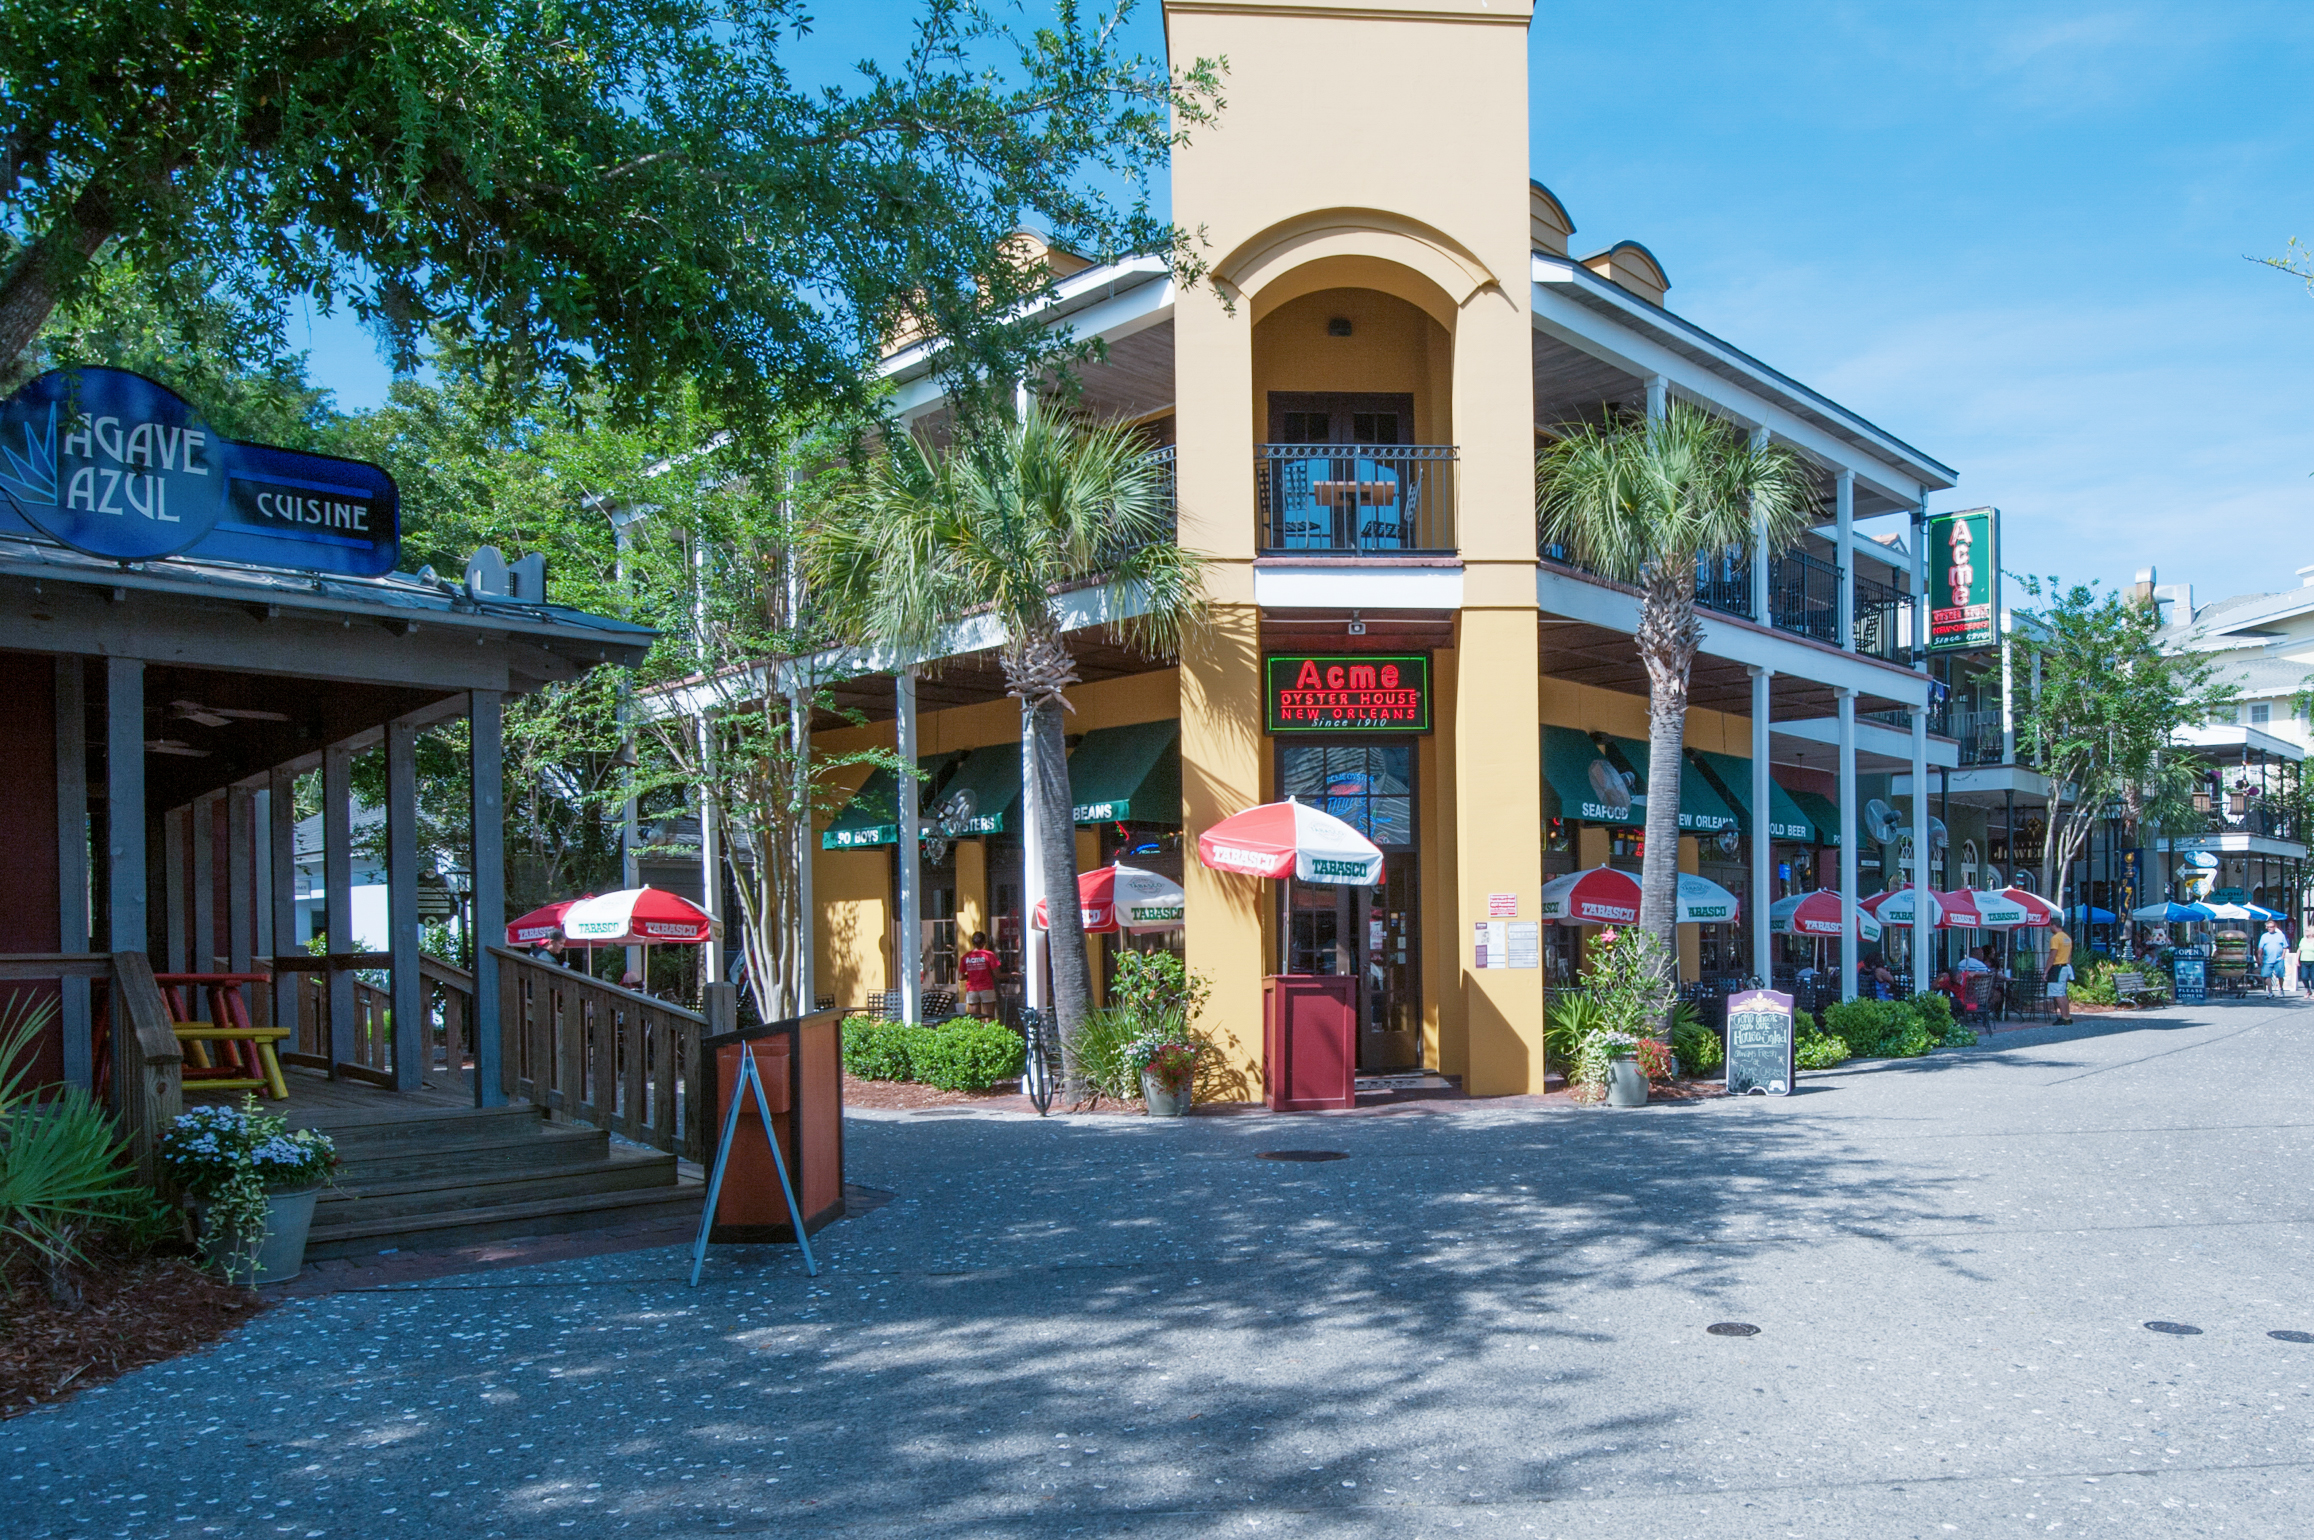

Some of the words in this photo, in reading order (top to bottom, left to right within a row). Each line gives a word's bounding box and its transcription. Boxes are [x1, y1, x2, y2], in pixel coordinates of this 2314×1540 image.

[64, 412, 209, 476] AGAVE
[67, 467, 181, 523] AZUL
[257, 492, 370, 532] CUISINE
[1949, 518, 1974, 607] Acme
[1296, 659, 1399, 690] Acme
[1281, 693, 1349, 705] OYSTER
[1360, 692, 1417, 705] HOUSE
[1281, 708, 1320, 720] NEW
[1333, 708, 1416, 719] ORLEANS
[1311, 717, 1349, 728] Since
[1356, 718, 1388, 727] 1910
[1073, 804, 1112, 822] BEANS
[1582, 802, 1629, 820] SEAFOOD
[948, 817, 995, 834] OYSTERS
[1679, 813, 1692, 826] EW
[838, 832, 852, 845] PO
[854, 829, 879, 844] BOYS
[1769, 823, 1785, 836] OLD
[1788, 825, 1807, 838] BEER
[1212, 845, 1277, 871] TABASCO
[1312, 859, 1367, 878] TABASCO
[1131, 907, 1185, 921] TABASCO
[1581, 902, 1636, 921] TABASCO
[1987, 912, 2020, 921] TABASCO
[578, 922, 619, 934] TABASCO
[645, 921, 698, 936] TABASCO
[1805, 920, 1842, 932] TABASC
[965, 956, 986, 965] Acme
